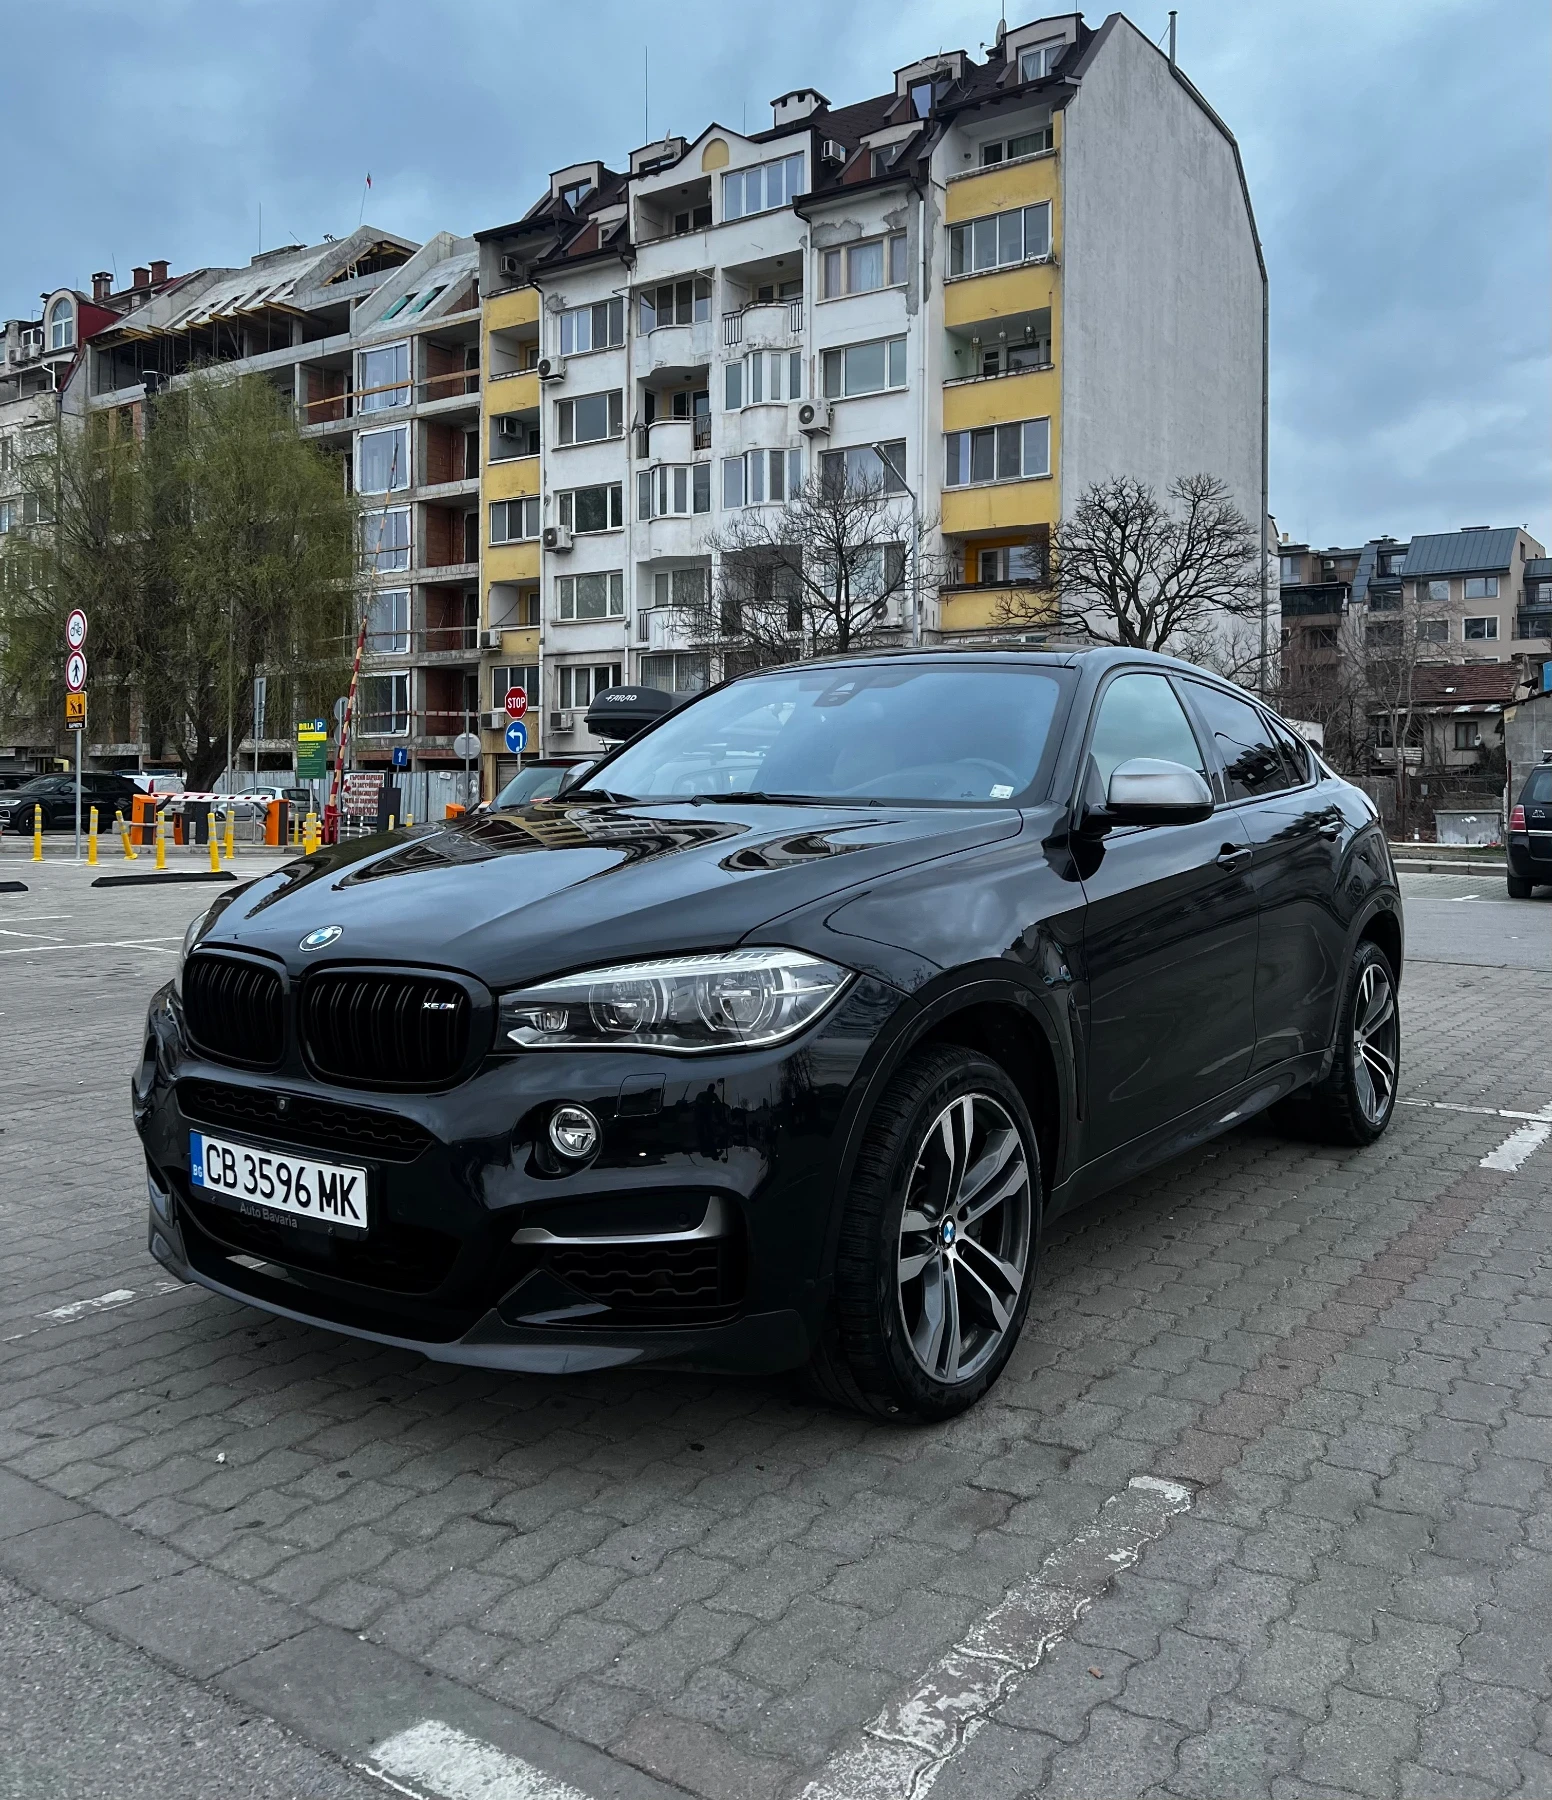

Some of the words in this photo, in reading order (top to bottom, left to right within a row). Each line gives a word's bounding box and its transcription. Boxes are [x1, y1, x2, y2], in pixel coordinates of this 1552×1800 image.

[507, 697, 526, 709] STOP
[605, 694, 637, 703] FARAD
[317, 722, 323, 730] P
[193, 1163, 203, 1178] BG
[206, 1143, 238, 1189] CB
[243, 1153, 312, 1208] 3596
[317, 1169, 361, 1220] MK
[240, 1202, 260, 1218] Auto
[262, 1208, 298, 1228] Bavaria
